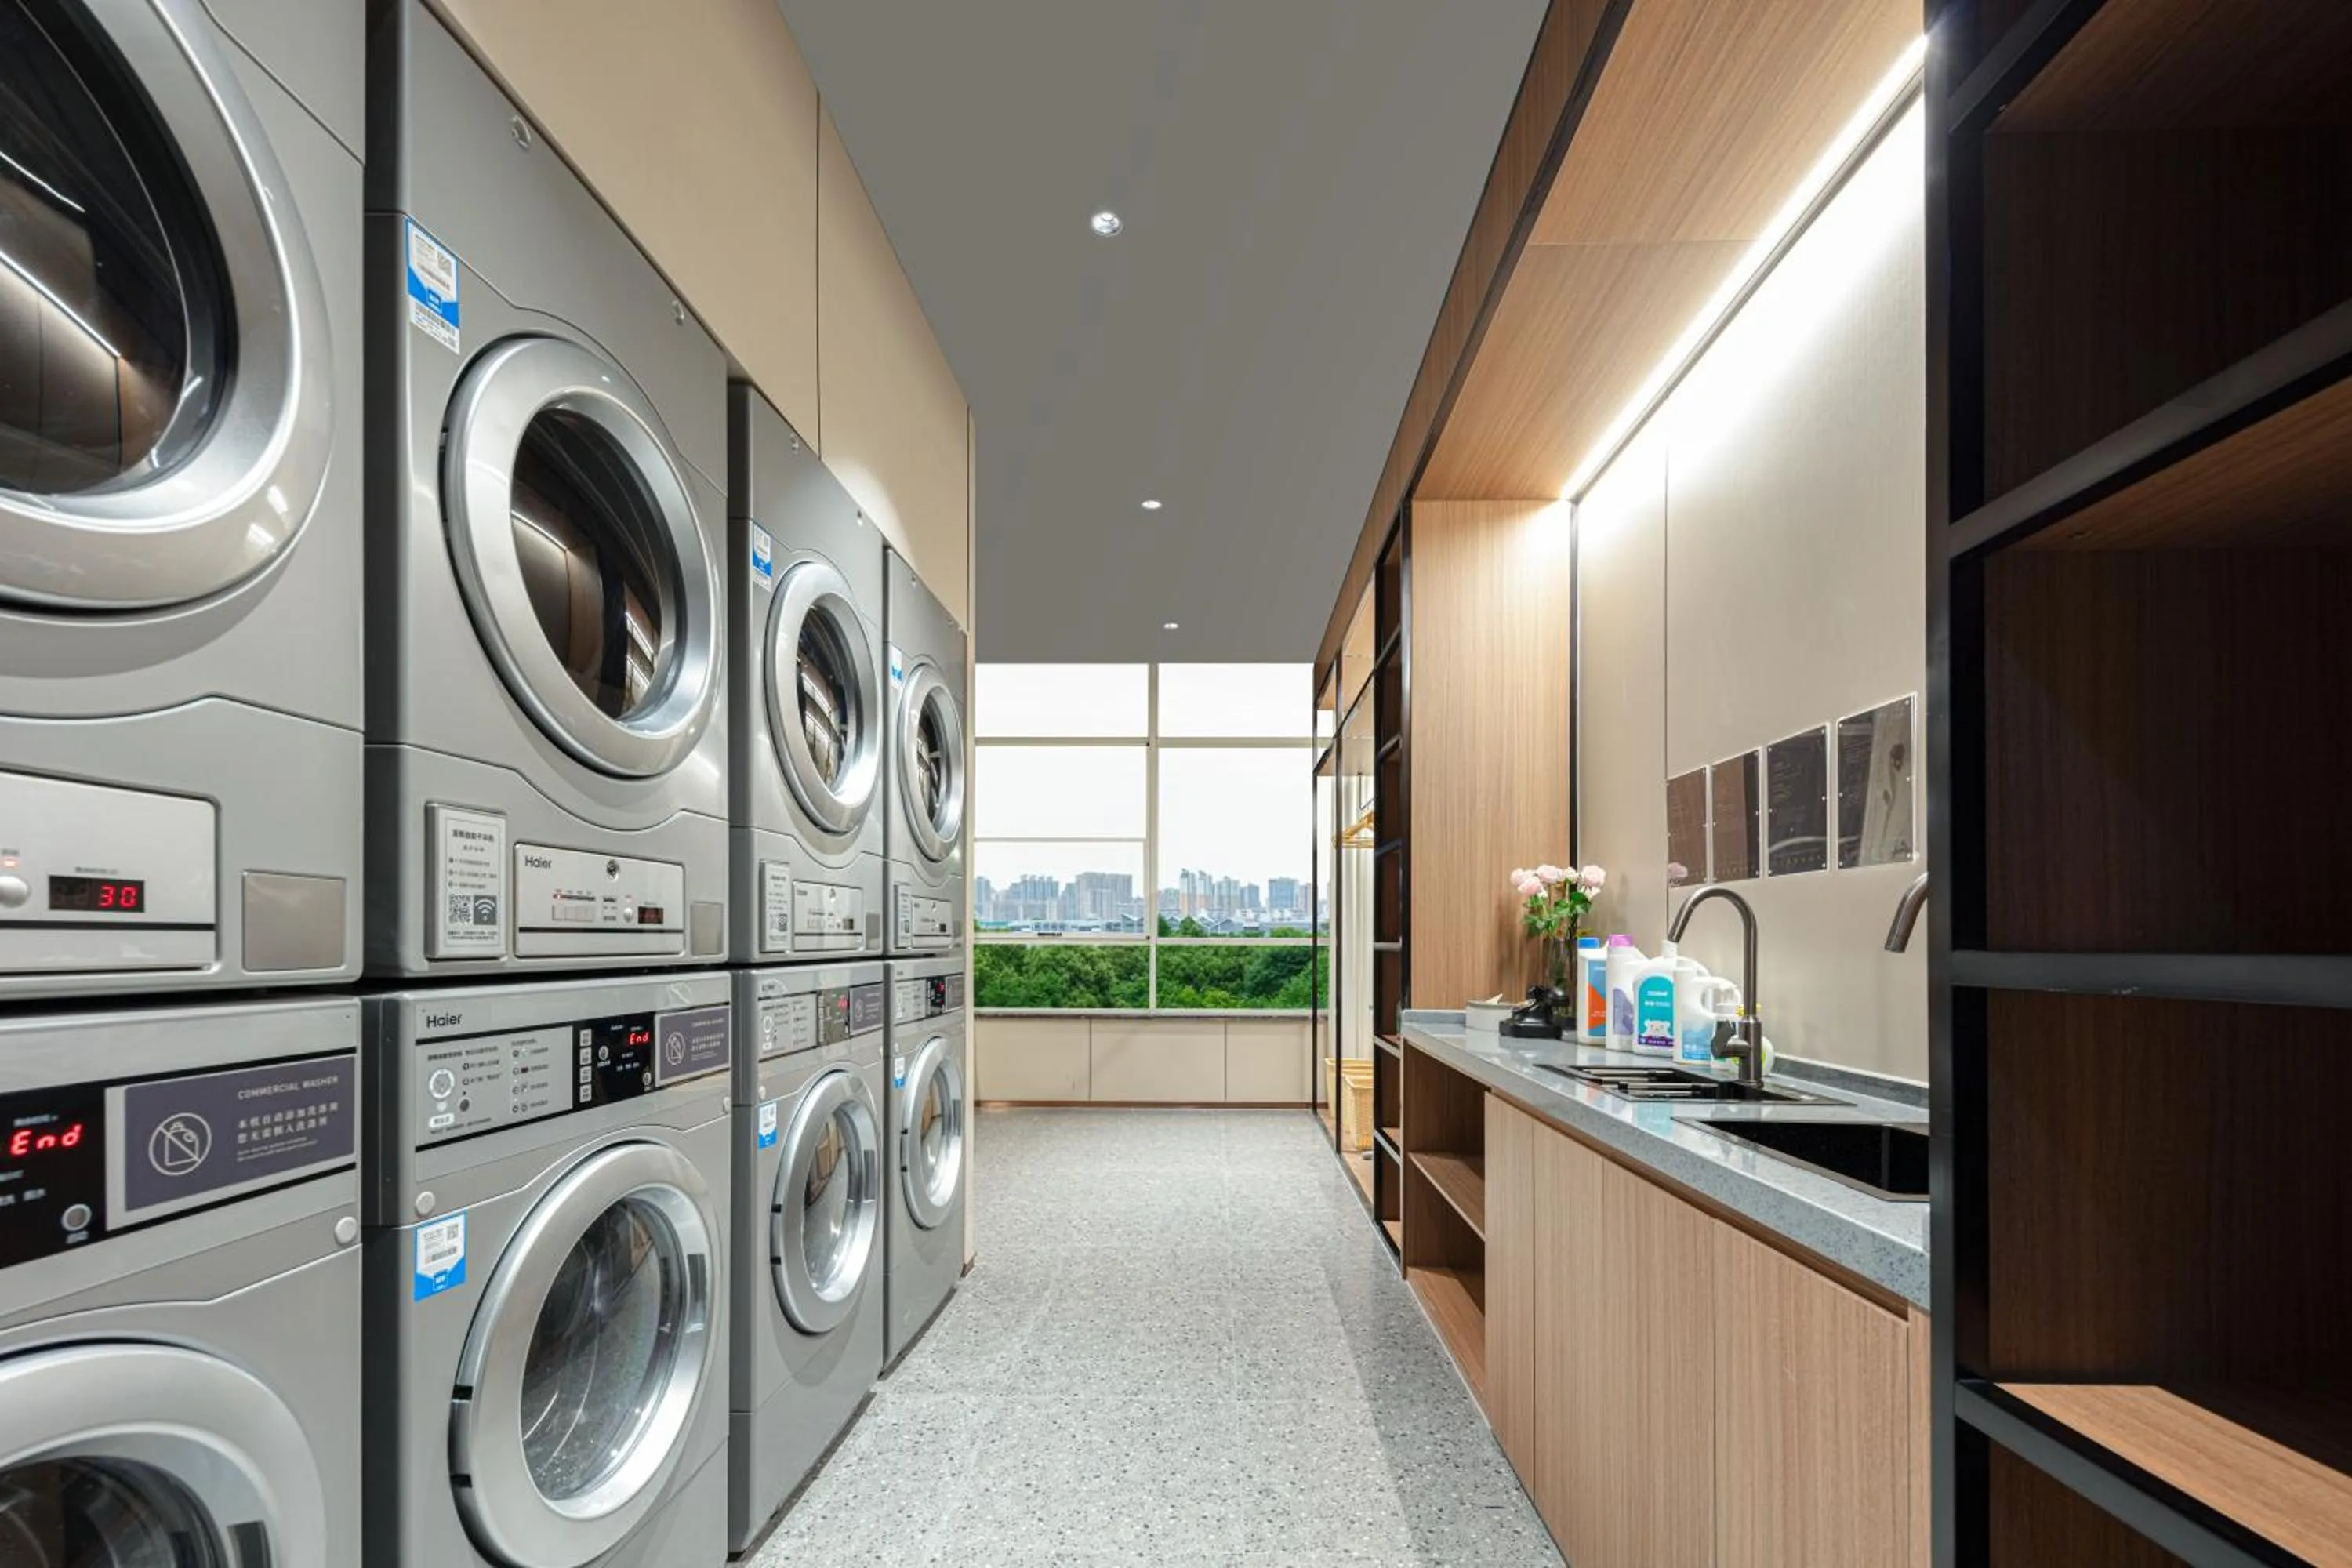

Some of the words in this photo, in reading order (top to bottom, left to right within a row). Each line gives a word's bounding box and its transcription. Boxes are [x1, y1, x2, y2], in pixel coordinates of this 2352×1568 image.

[524, 855, 552, 869] Haier
[99, 885, 137, 909] 30
[426, 1011, 463, 1029] Haier
[629, 1033, 650, 1045] End
[238, 1082, 299, 1100] COMMERCIAL
[302, 1076, 338, 1089] WASHER
[10, 1123, 82, 1156] End
